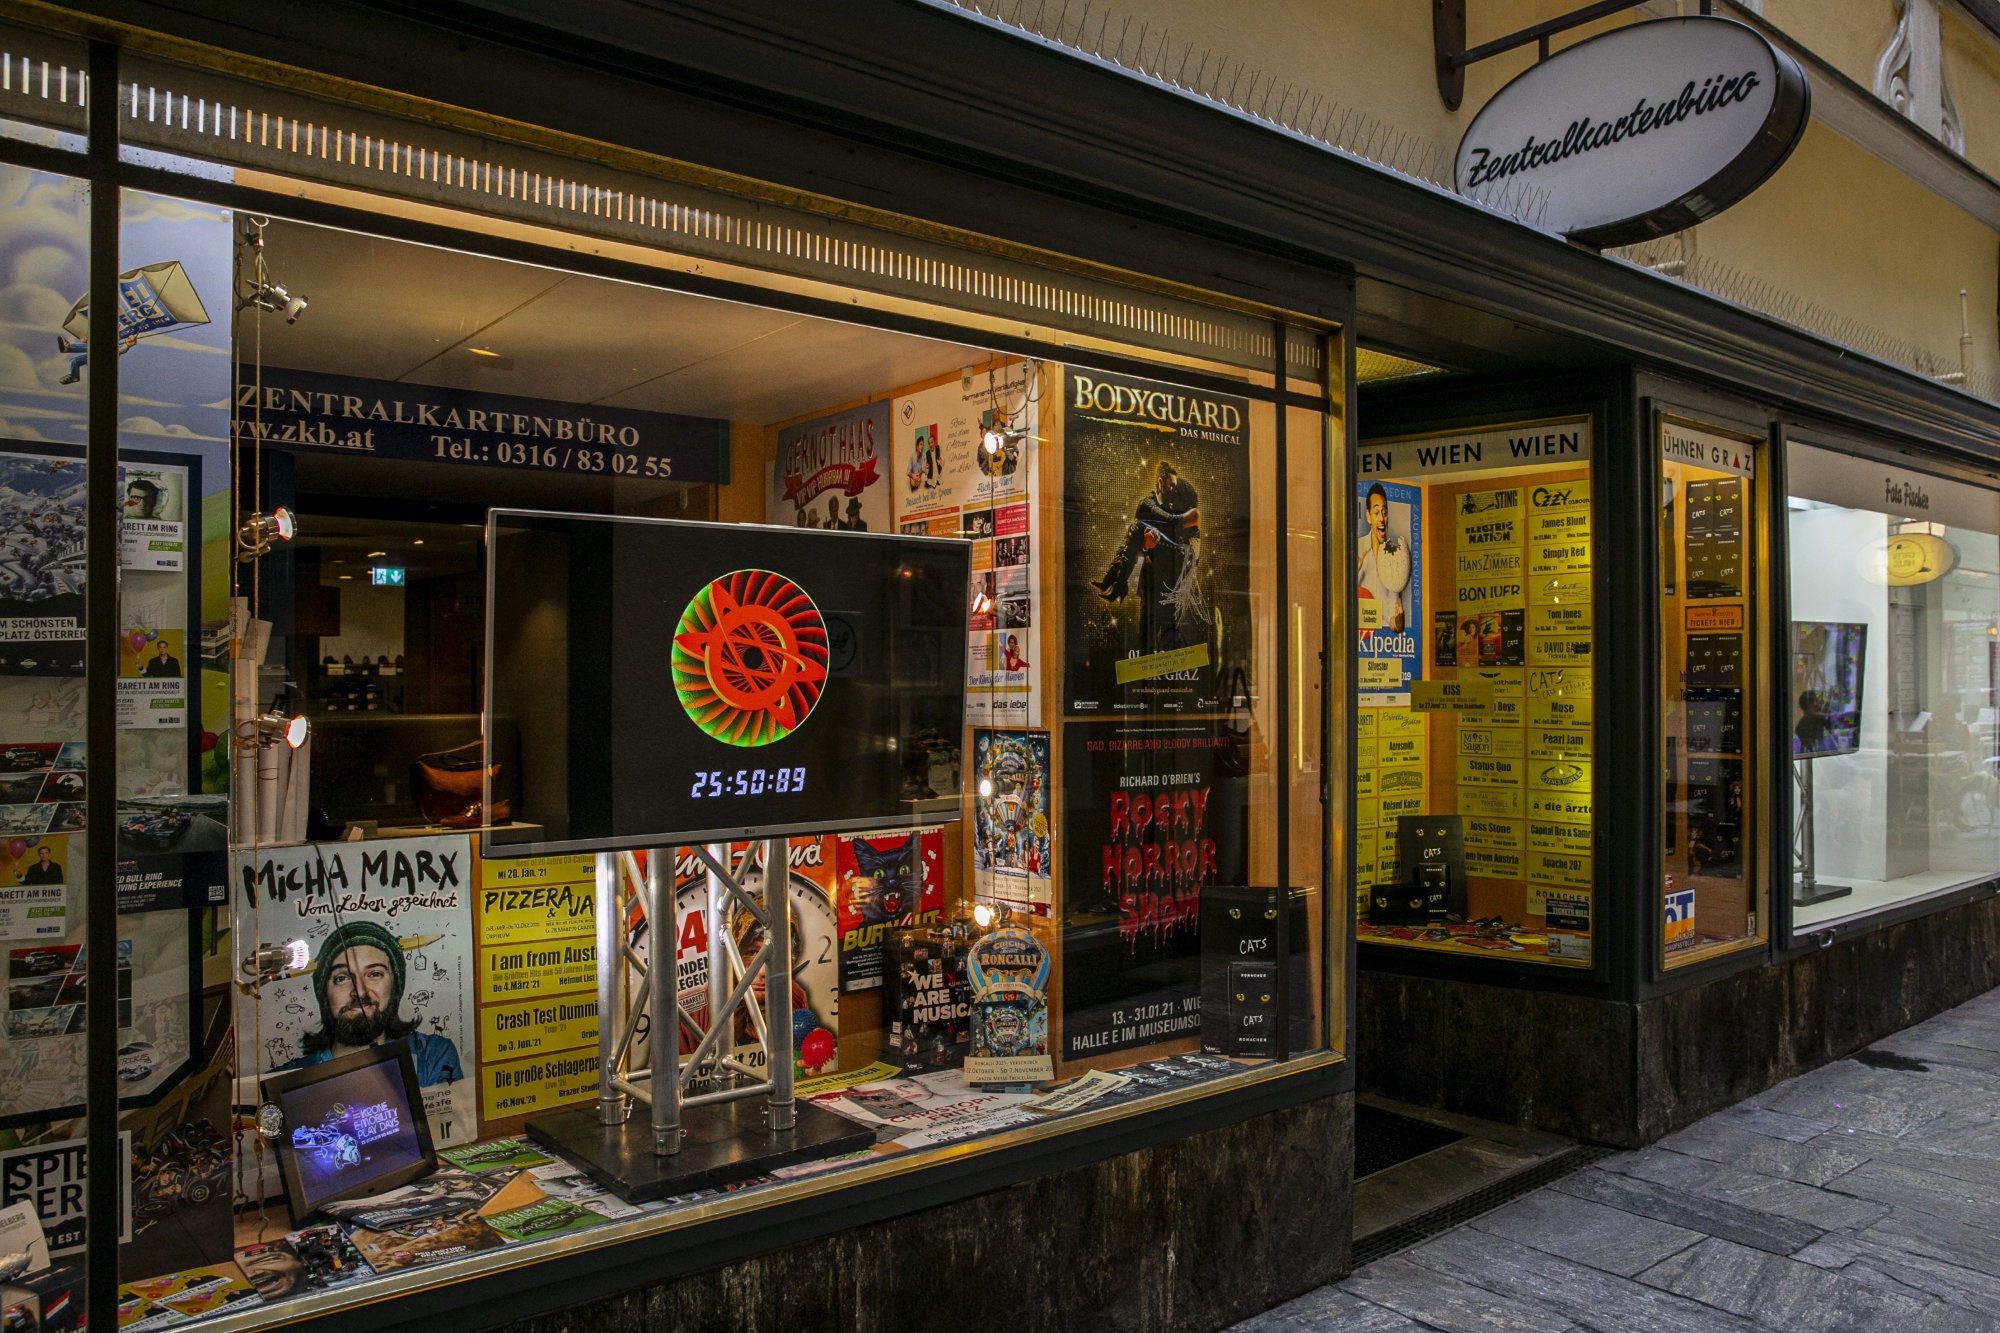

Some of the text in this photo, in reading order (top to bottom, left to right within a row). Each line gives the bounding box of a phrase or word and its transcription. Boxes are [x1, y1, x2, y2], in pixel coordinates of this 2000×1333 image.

[1467, 71, 1759, 187] Zentralkartenbüro
[1073, 375, 1241, 433] BODYGUARD
[238, 384, 640, 447] ZENTRALKARTENBÜRO
[231, 420, 374, 449] w.zkb.at
[1180, 427, 1241, 445] DAS MUSICAL
[785, 418, 875, 477] GERNOT HAAS
[1509, 432, 1578, 457] WIEN
[1664, 428, 1704, 460] ÜHNEN
[431, 435, 672, 477] Tel.: 0316 83 02 55
[1417, 442, 1481, 467] WIEN
[1495, 490, 1518, 509] STING
[1542, 516, 1586, 529] James Blunt
[1543, 546, 1585, 559] Simply Red
[1460, 586, 1486, 601] BON
[1548, 609, 1581, 619] Tom Jones
[11, 617, 74, 629] SCHÖNSTEN
[162, 682, 180, 690] RING
[1442, 684, 1461, 696] KISS
[1551, 702, 1574, 713] Muse
[1109, 739, 1142, 752] BIZARRE
[1144, 739, 1161, 750] AND
[1163, 738, 1191, 750] BLOODY
[1543, 733, 1583, 746] Pearl Jam
[1469, 760, 1512, 772] Status Quo
[1119, 775, 1159, 788] RICHARD
[1404, 799, 1421, 809] Kaiser
[1545, 801, 1562, 811] die
[1110, 786, 1211, 845] ROCKY
[1470, 821, 1511, 834] Joss Stone
[1530, 824, 1566, 836] Capital Bra
[1424, 848, 1441, 859] CATS
[1477, 852, 1493, 862] from
[1494, 854, 1519, 865] Austria
[1102, 838, 1218, 895] HORROR
[1542, 857, 1581, 871] Apache 207
[145, 872, 163, 881] RING
[362, 849, 460, 898] MARX
[139, 878, 184, 890] EXPERIENCE
[27, 888, 61, 898] AM RING
[484, 886, 574, 914] PIZZERA
[297, 891, 457, 917] Vom Leben gezeichnet
[547, 895, 594, 918] & JA
[992, 940, 1026, 951] CIRCUS
[1239, 937, 1268, 955] CATS
[491, 945, 598, 971] I am from Aust
[980, 953, 1038, 967] RONCALLI
[560, 974, 595, 985] Helmut List
[914, 973, 944, 991] WE
[913, 988, 950, 1008] ARE
[496, 1000, 598, 1031] Crash Test Dummi
[913, 1002, 970, 1024] MUSIC
[1112, 995, 1201, 1026] 13. 31.01.21 WIE
[1243, 1013, 1264, 1027] CATS
[1072, 1031, 1109, 1051] HALLE
[1112, 1030, 1119, 1044] E
[1122, 1025, 1136, 1042] IM
[495, 1070, 511, 1088] Die
[514, 1064, 543, 1087] große
[927, 1105, 988, 1121] FRITZ
[379, 1117, 400, 1132] DAYS
[60, 1231, 80, 1245] EST
